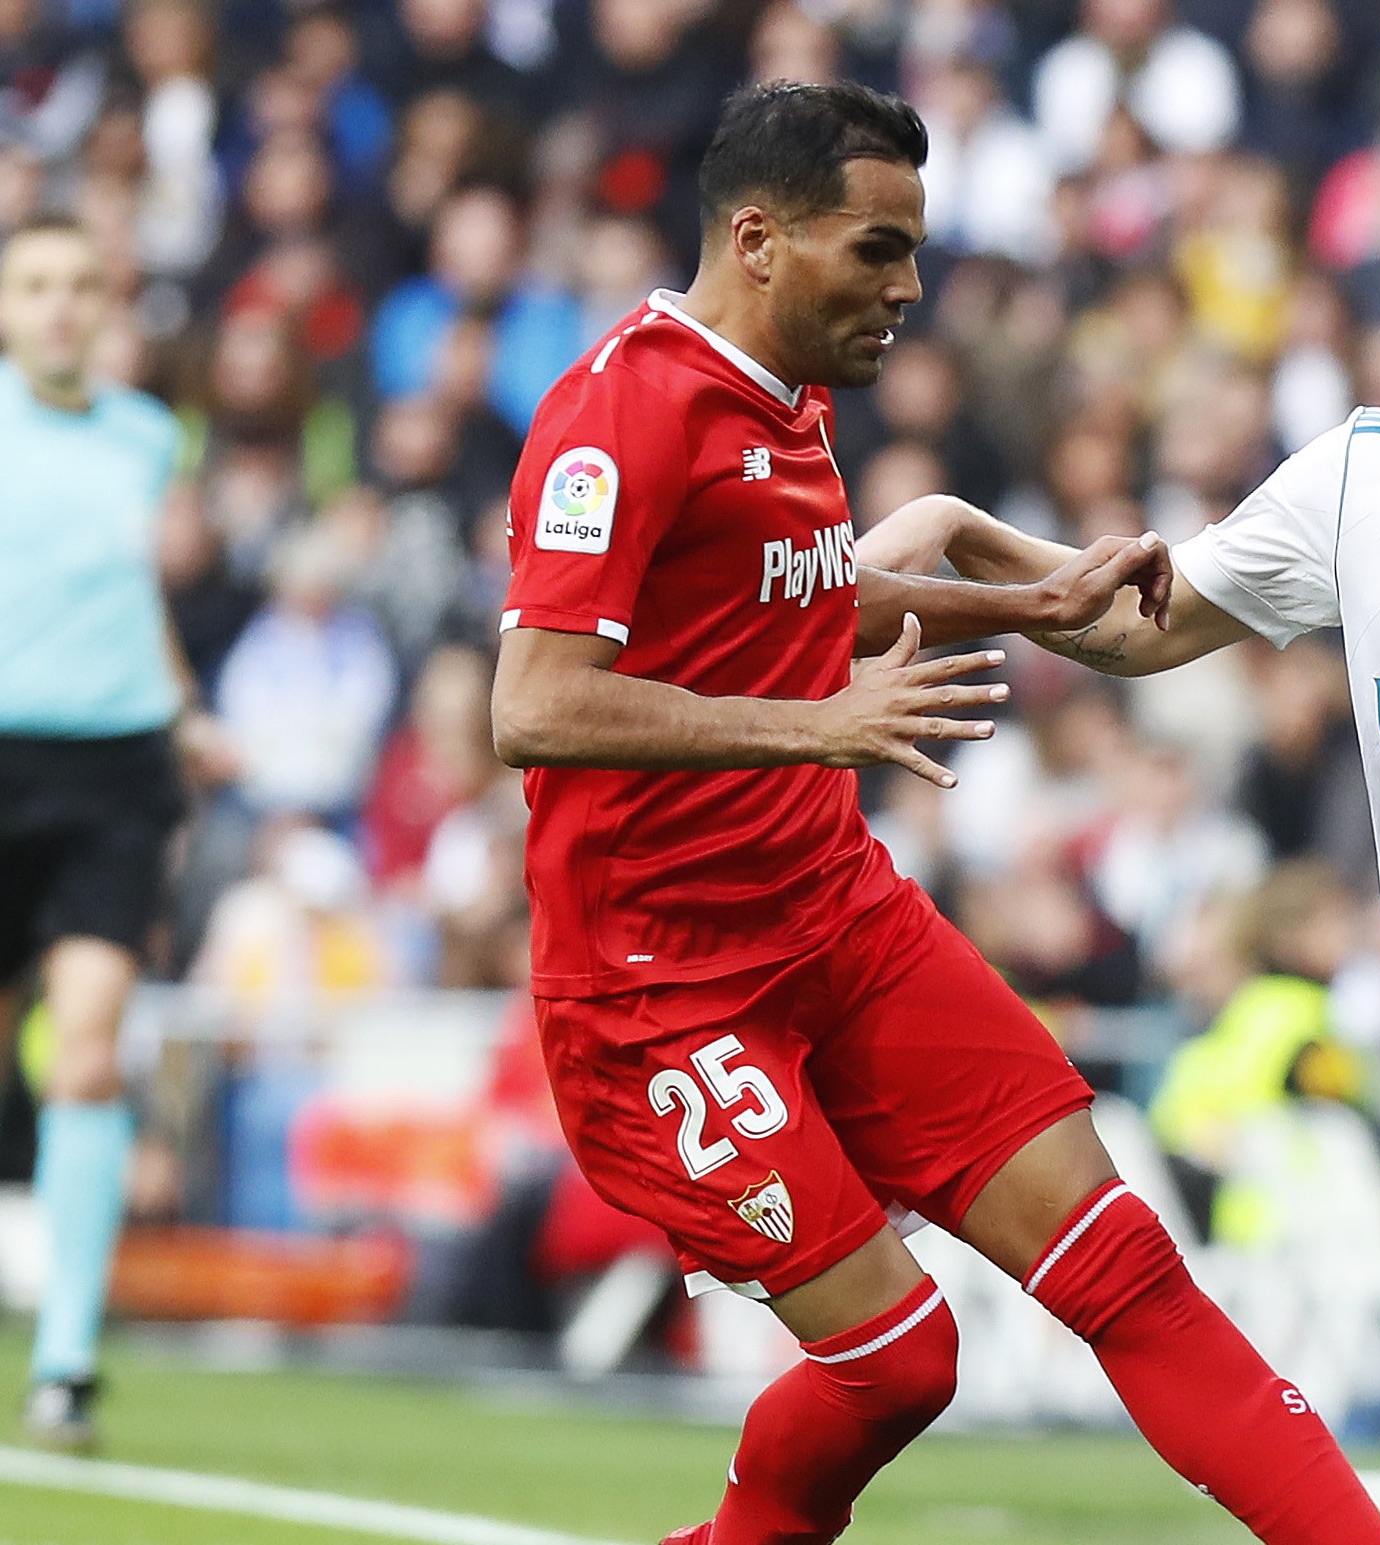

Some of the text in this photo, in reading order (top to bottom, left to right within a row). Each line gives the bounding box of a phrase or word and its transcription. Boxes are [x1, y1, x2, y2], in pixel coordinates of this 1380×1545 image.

[545, 520, 602, 540] LaLiga
[759, 519, 857, 608] PlayWS
[647, 1033, 788, 1181] 25
[1281, 1388, 1316, 1414] S
